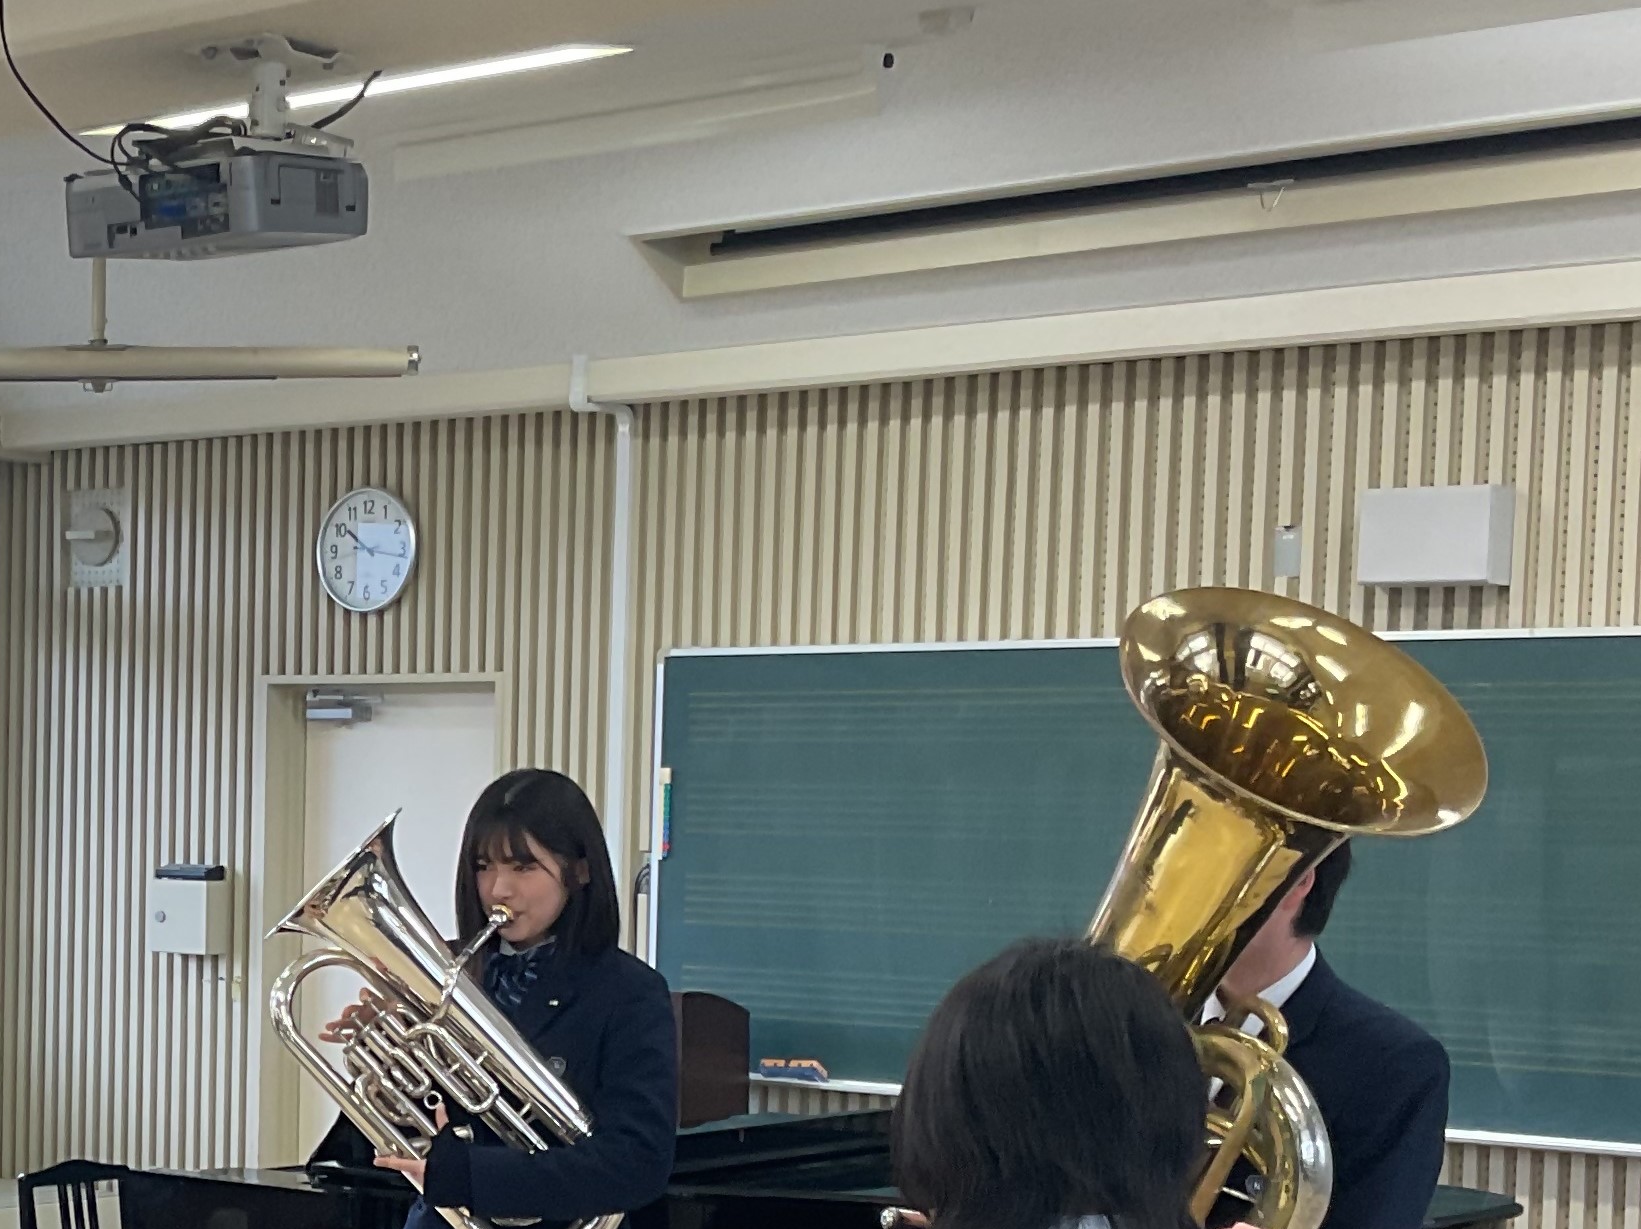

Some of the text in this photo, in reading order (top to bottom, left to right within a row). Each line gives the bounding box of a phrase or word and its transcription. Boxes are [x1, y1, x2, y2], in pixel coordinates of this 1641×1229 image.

[348, 506, 357, 521] 11
[363, 499, 375, 515] 12
[383, 504, 388, 519] 1
[335, 522, 347, 538] 10
[394, 519, 402, 534] 2
[330, 544, 338, 560] 9
[400, 541, 407, 557] 3
[334, 565, 343, 580] 8
[392, 563, 400, 578] 4
[347, 580, 355, 596] 7
[363, 584, 371, 601] 6
[380, 579, 388, 594] 5
